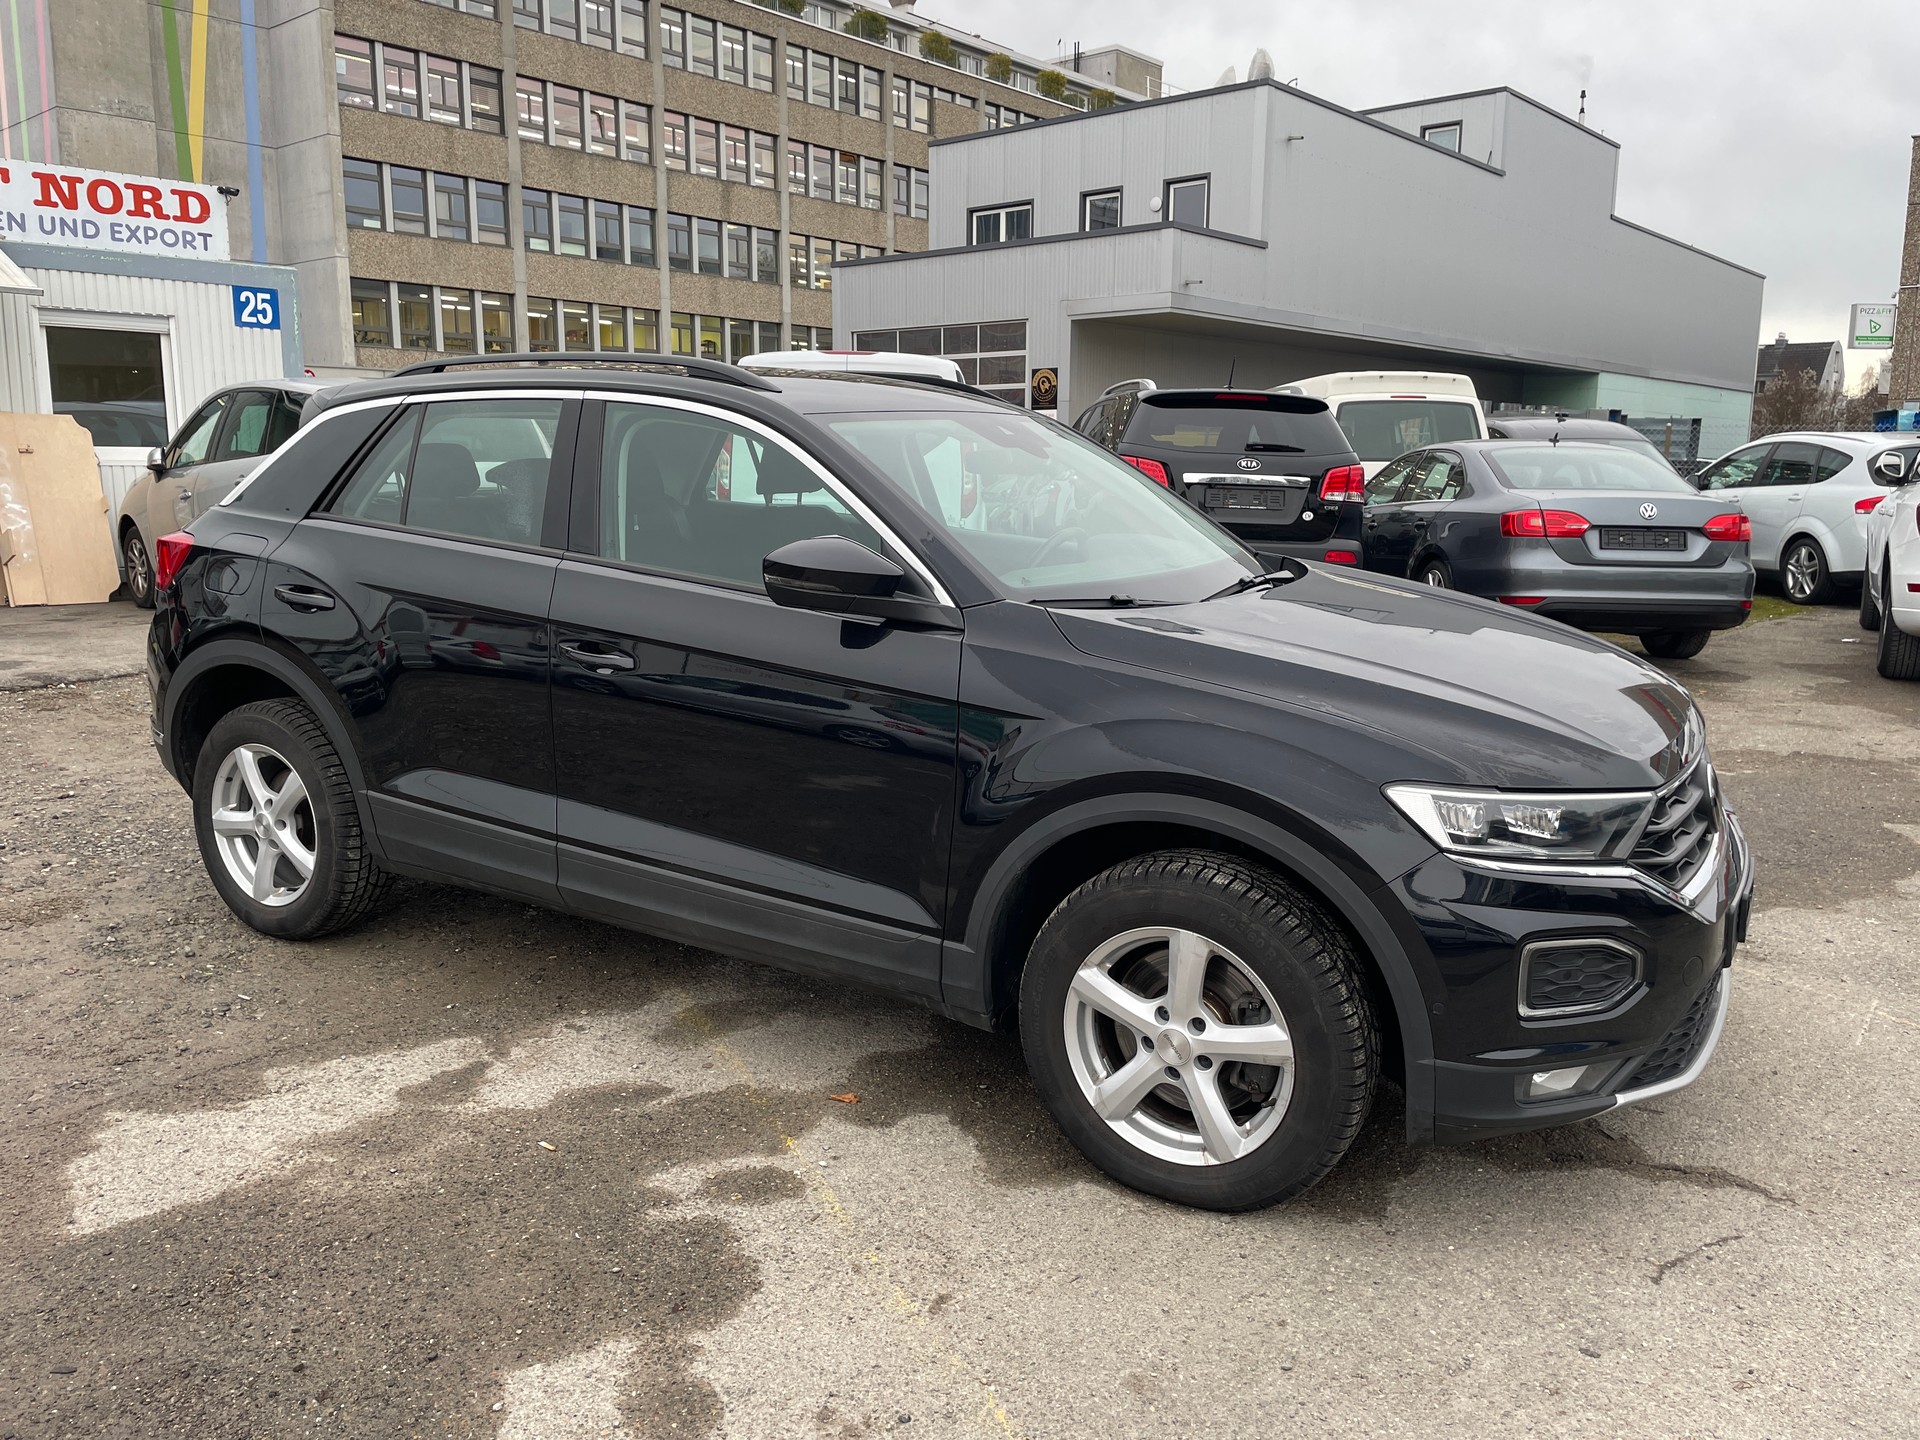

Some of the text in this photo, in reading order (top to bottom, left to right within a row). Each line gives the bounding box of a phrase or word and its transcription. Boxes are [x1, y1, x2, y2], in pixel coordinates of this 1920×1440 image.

[31, 171, 211, 225] NORD
[38, 214, 101, 239] UND
[109, 222, 213, 251] EXPORT
[239, 291, 273, 325] 25
